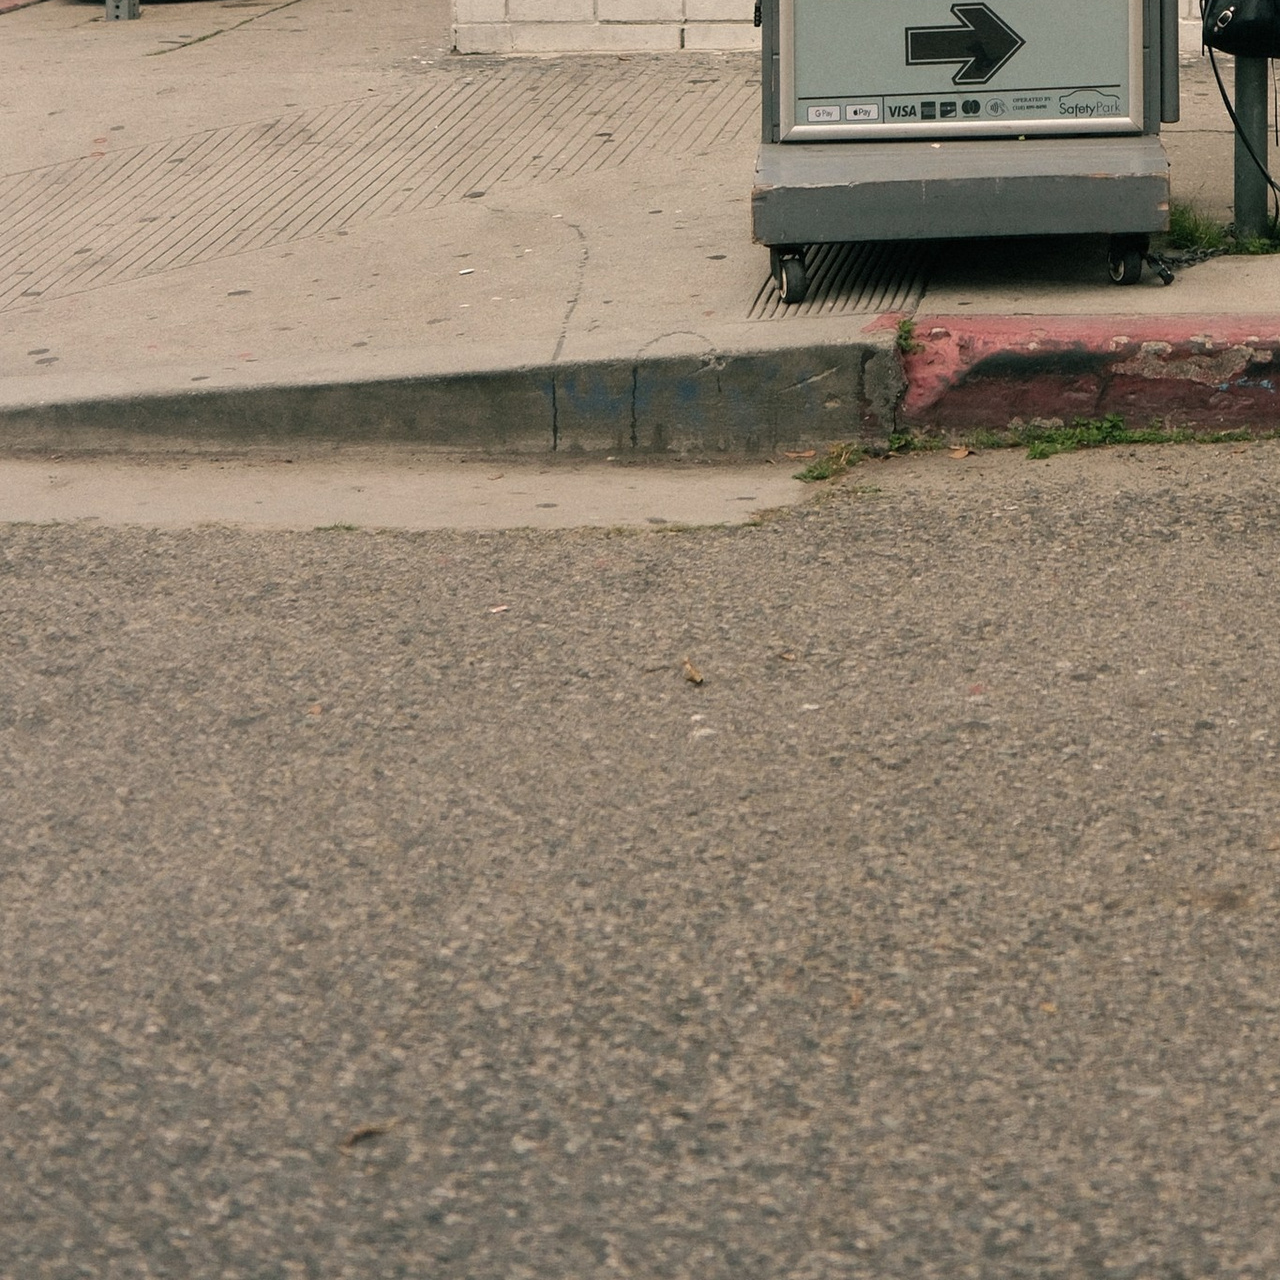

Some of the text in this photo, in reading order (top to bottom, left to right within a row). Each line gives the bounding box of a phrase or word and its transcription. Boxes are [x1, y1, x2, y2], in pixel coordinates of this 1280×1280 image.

[822, 109, 834, 118] Pay
[858, 107, 872, 117] Pay
[888, 105, 917, 118] VISA
